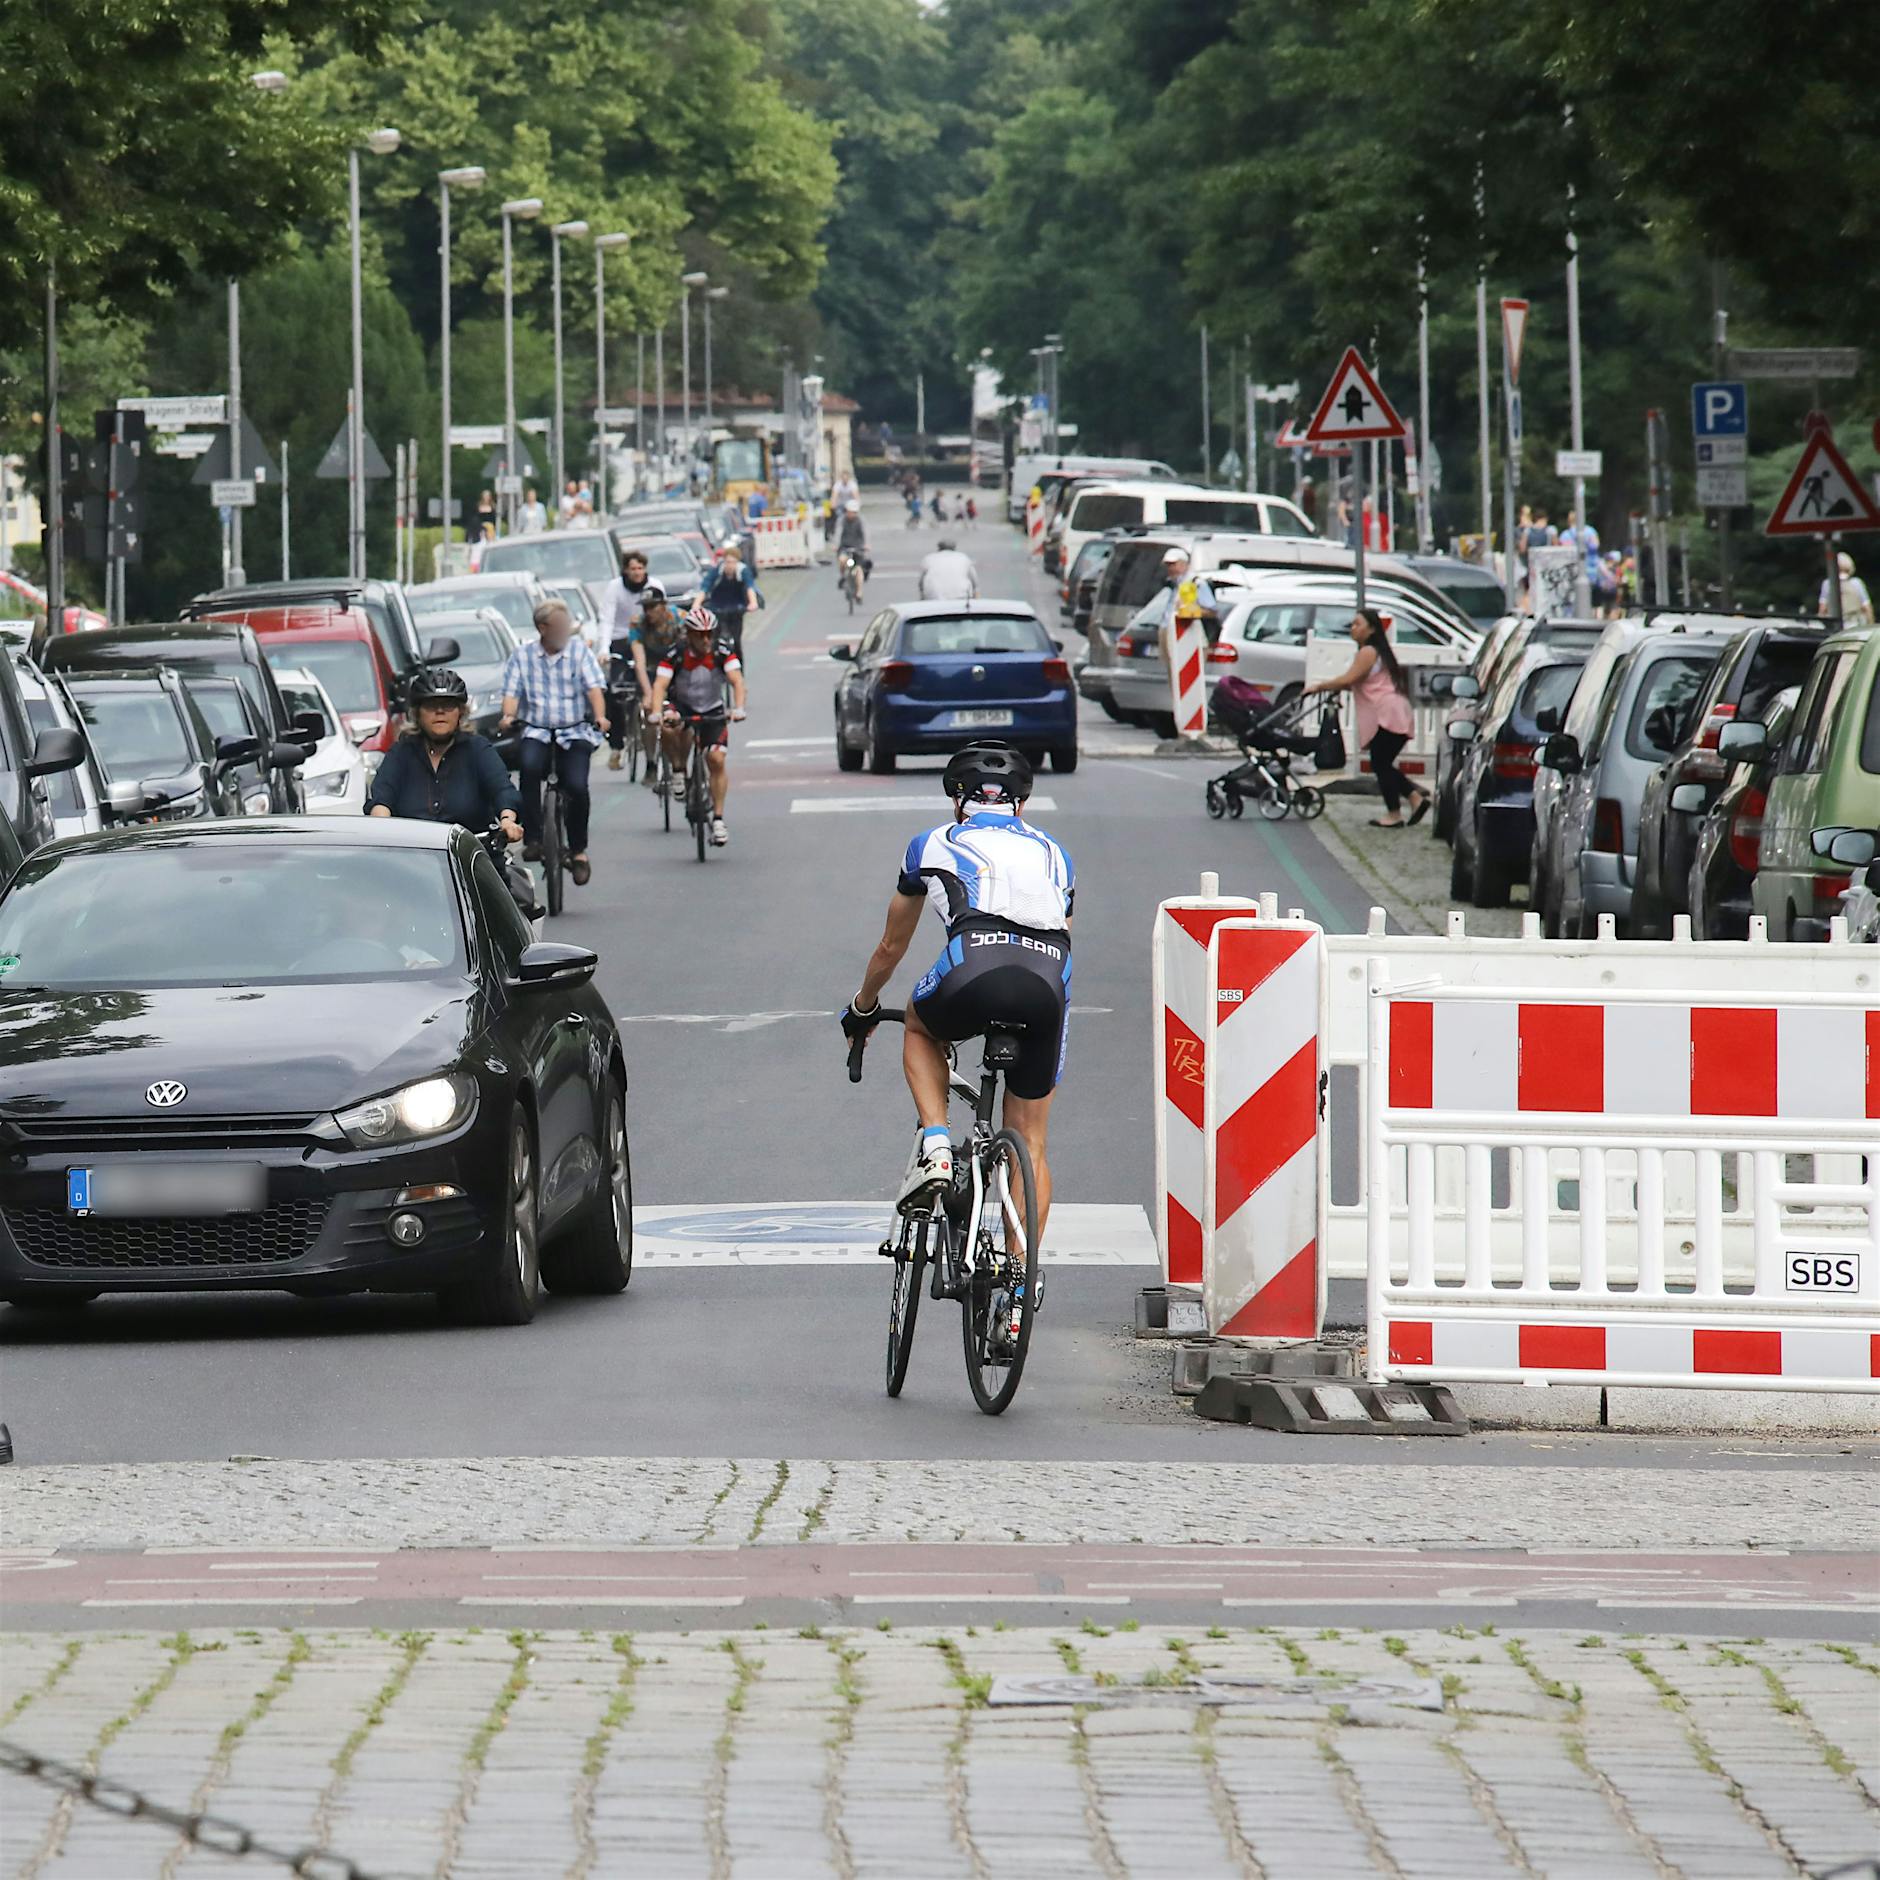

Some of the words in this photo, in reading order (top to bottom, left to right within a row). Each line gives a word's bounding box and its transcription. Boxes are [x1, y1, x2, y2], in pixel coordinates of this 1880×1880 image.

[1706, 390, 1734, 430] P
[1219, 990, 1242, 1001] SBS
[75, 1192, 83, 1202] D
[1791, 1258, 1855, 1287] SBS
